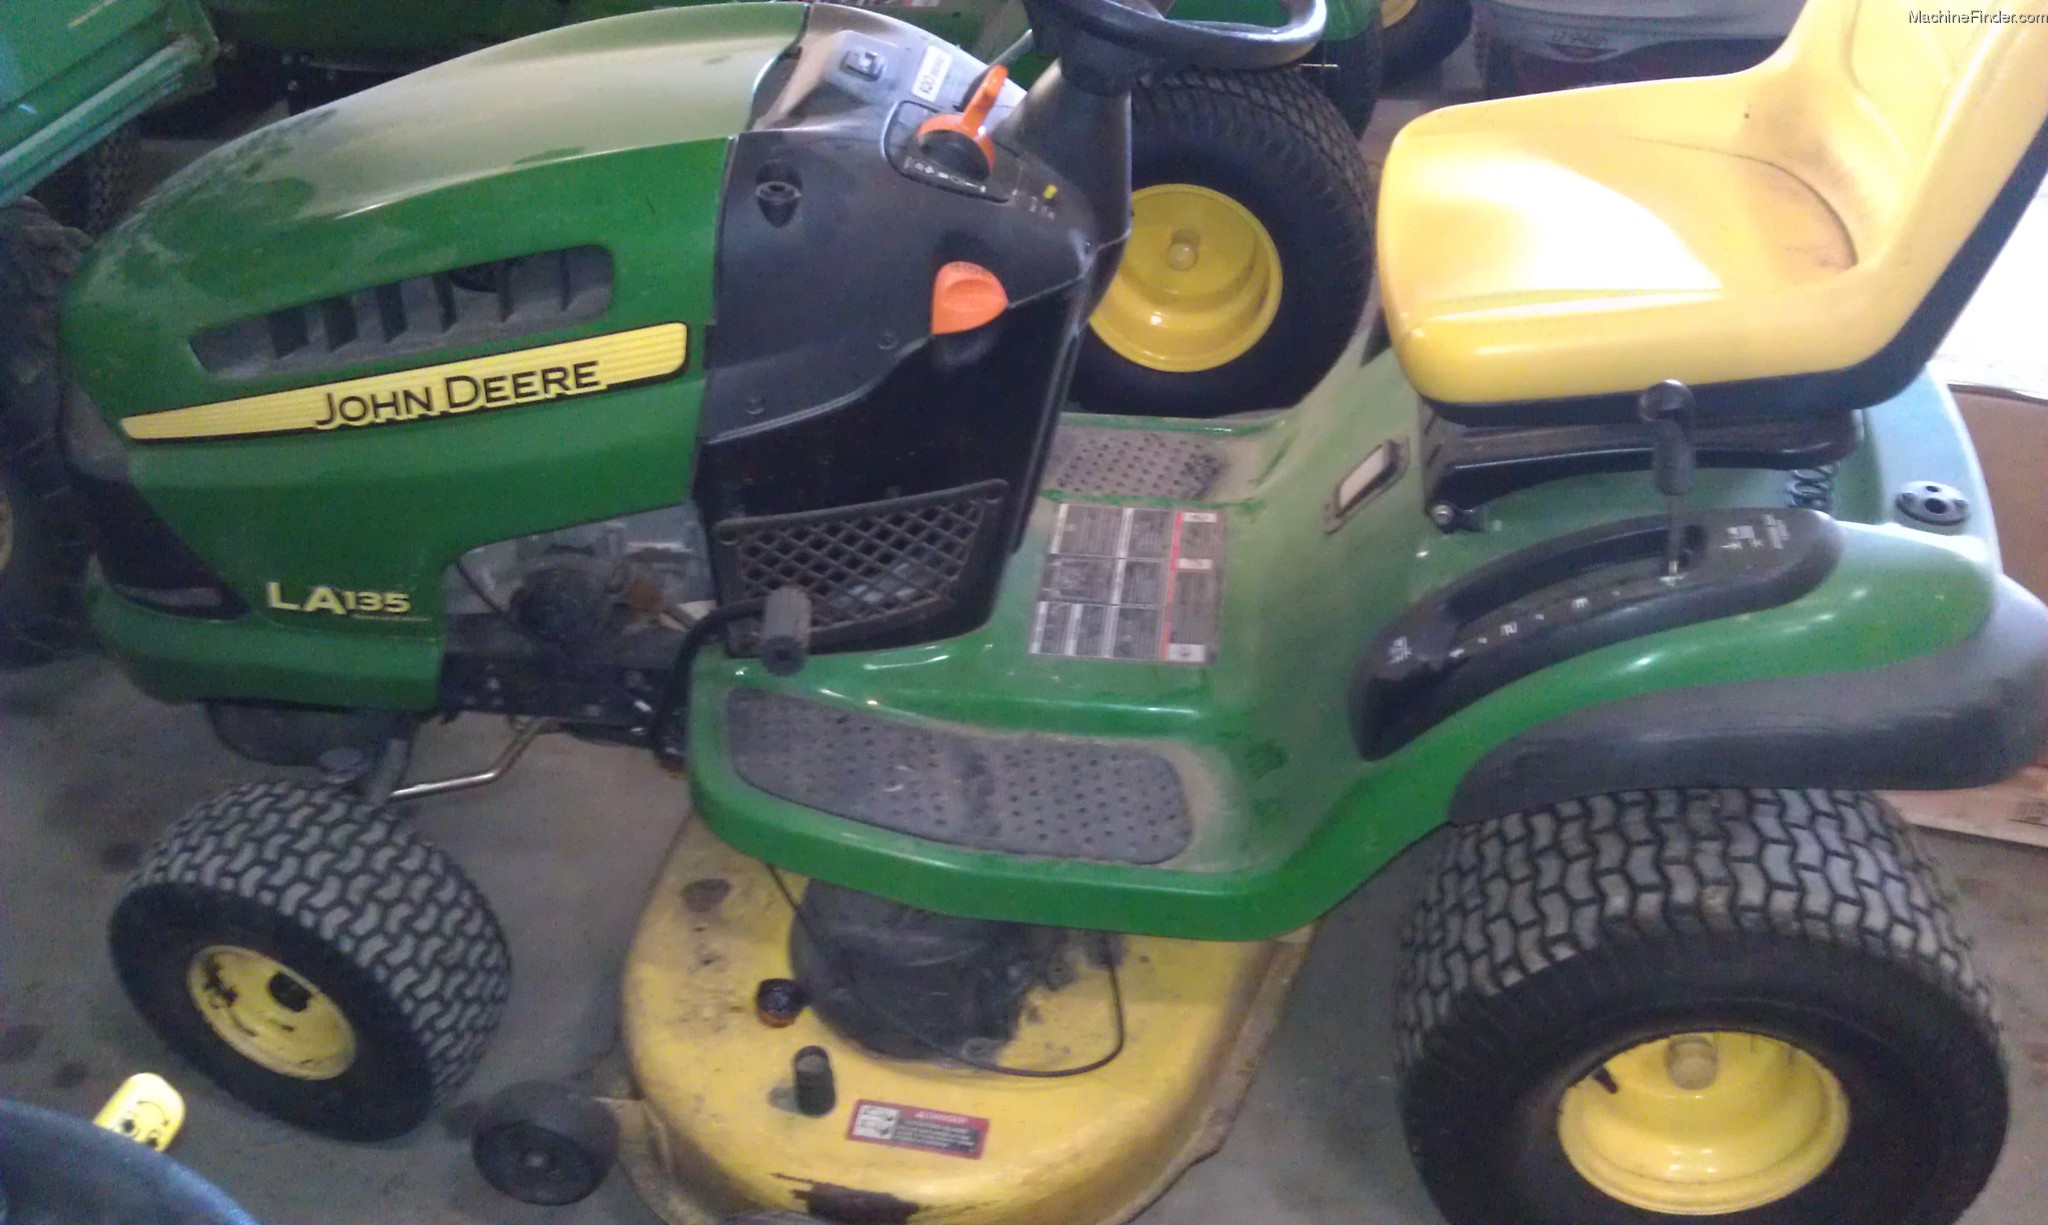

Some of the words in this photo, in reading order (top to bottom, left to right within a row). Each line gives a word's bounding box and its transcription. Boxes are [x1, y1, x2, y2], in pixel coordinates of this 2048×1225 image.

[315, 386, 432, 425] JOHN
[445, 360, 600, 409] DEERE
[267, 581, 411, 615] LA135
